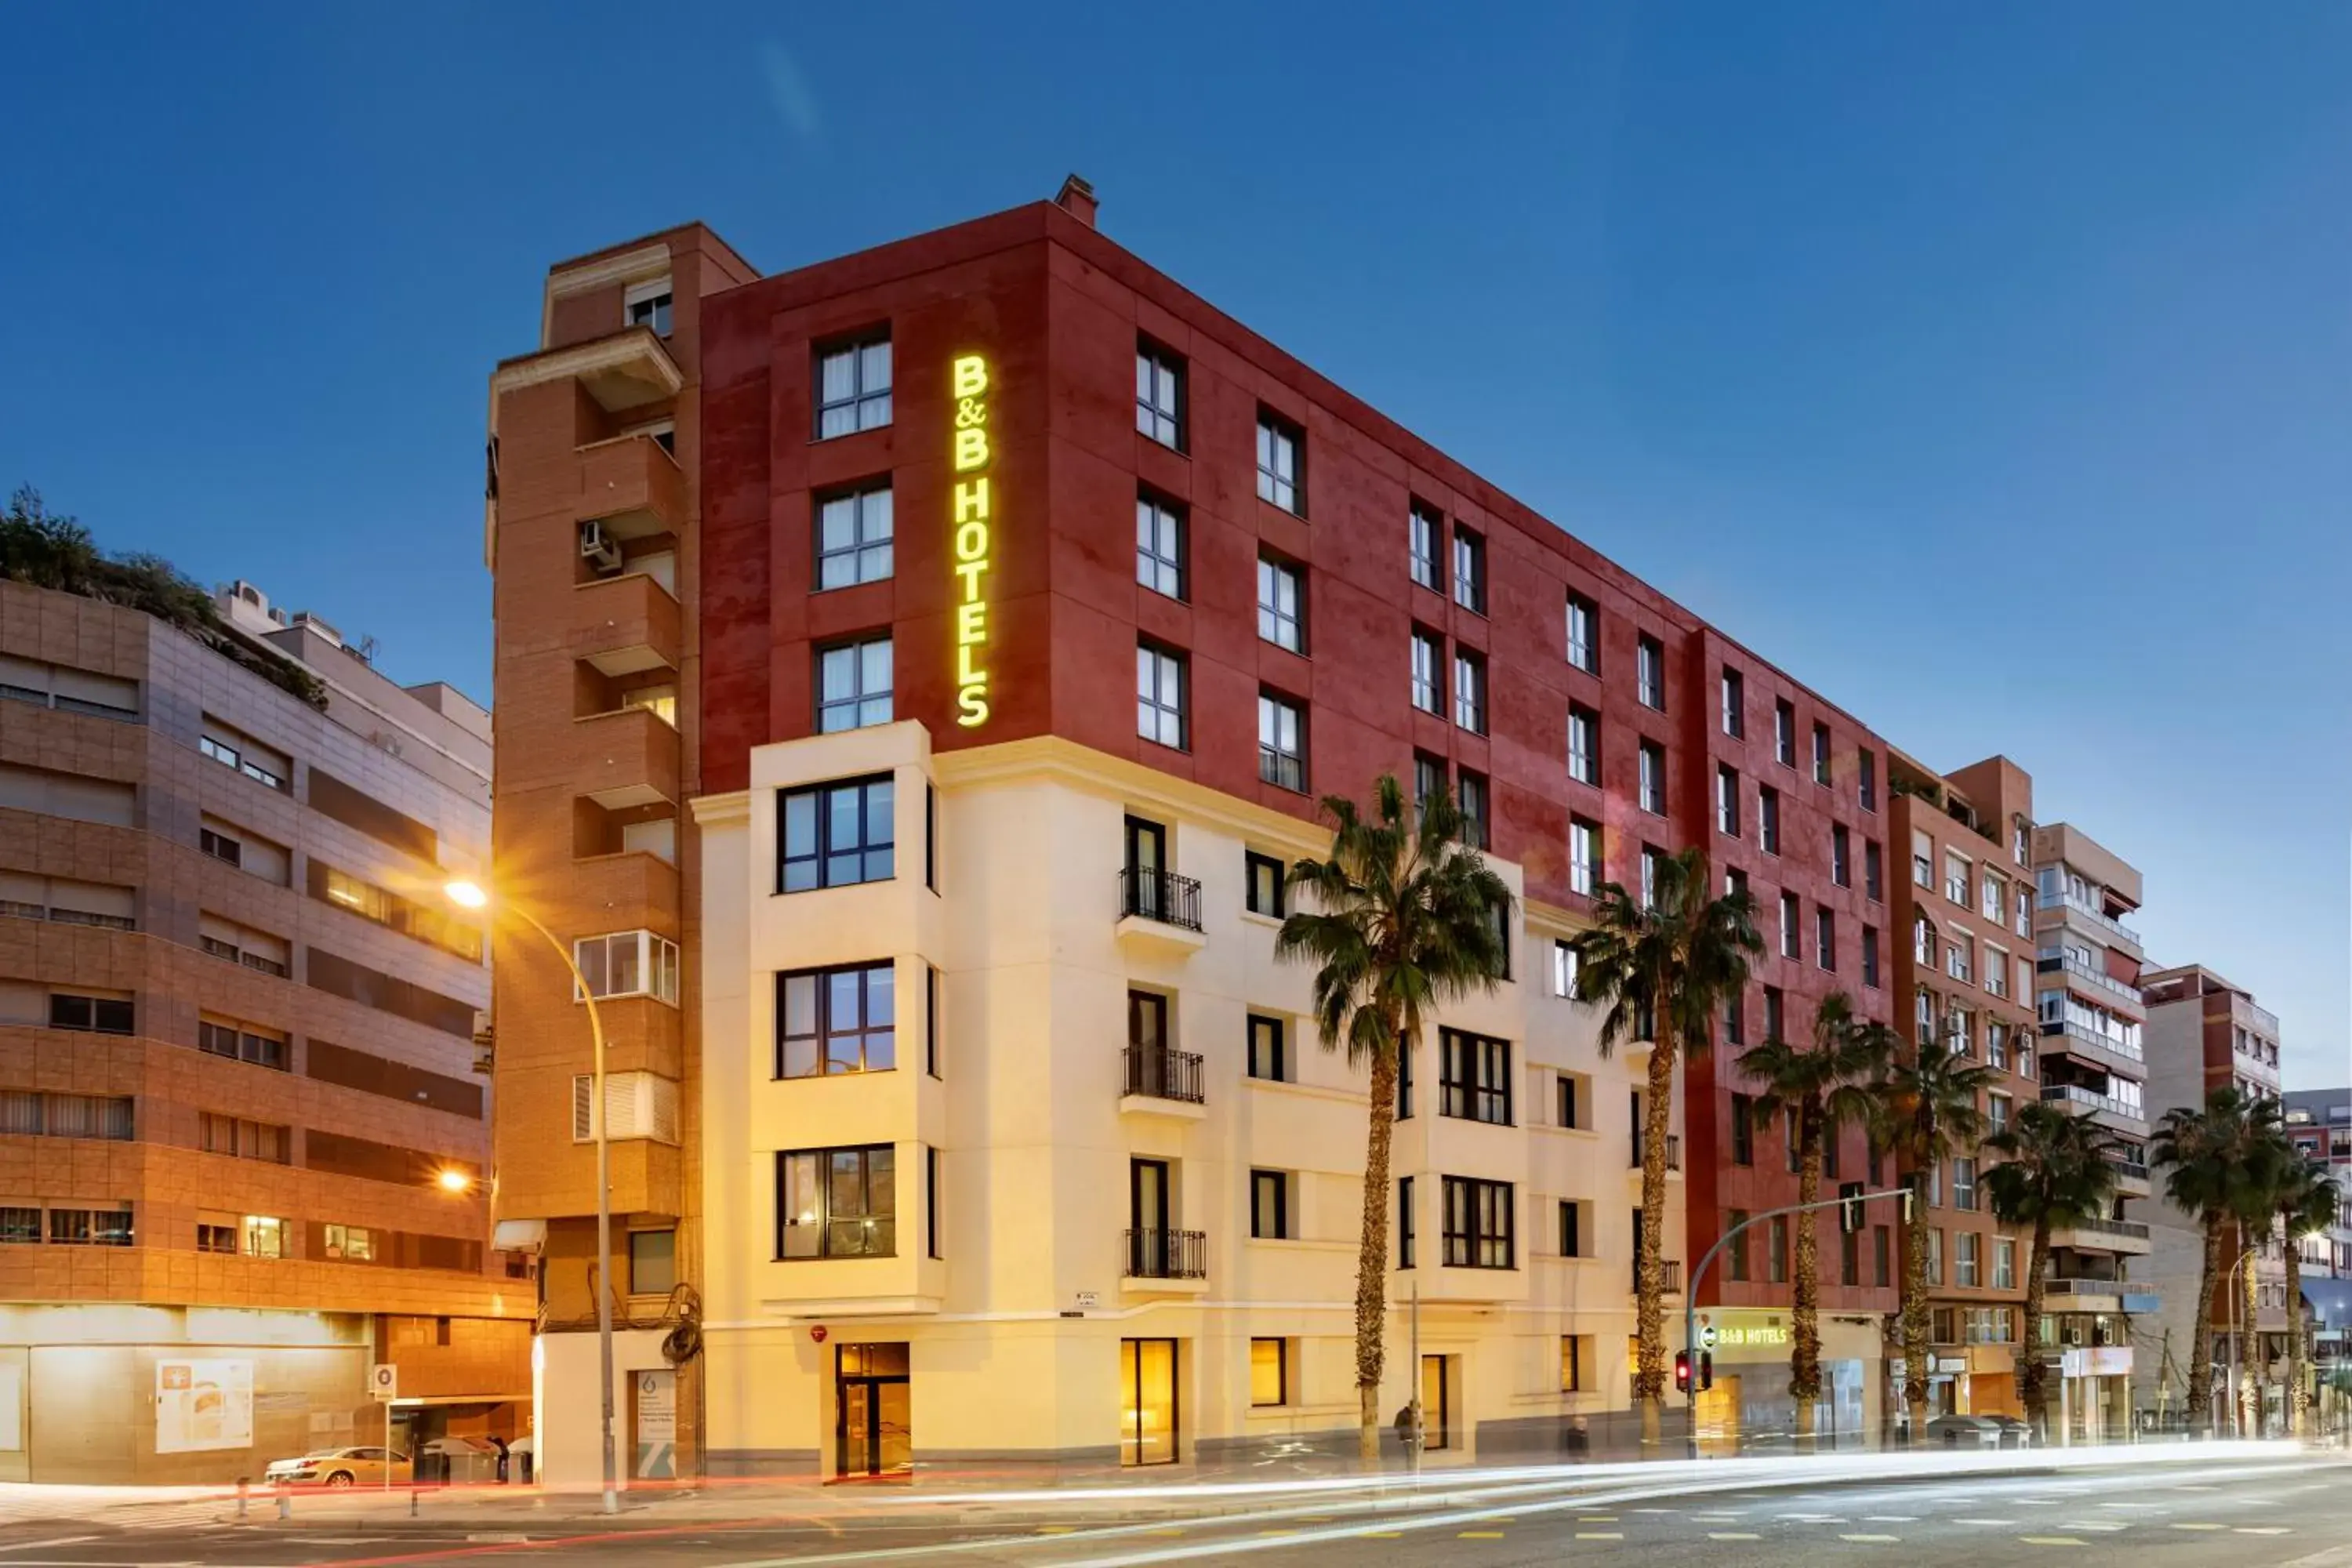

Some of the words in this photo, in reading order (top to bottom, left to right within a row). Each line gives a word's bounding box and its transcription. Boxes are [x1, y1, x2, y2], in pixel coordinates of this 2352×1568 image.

[954, 355, 989, 471] B&B
[955, 478, 989, 726] HOTELS
[1719, 1329, 1744, 1343] B&B
[1746, 1329, 1787, 1343] HOTELS
